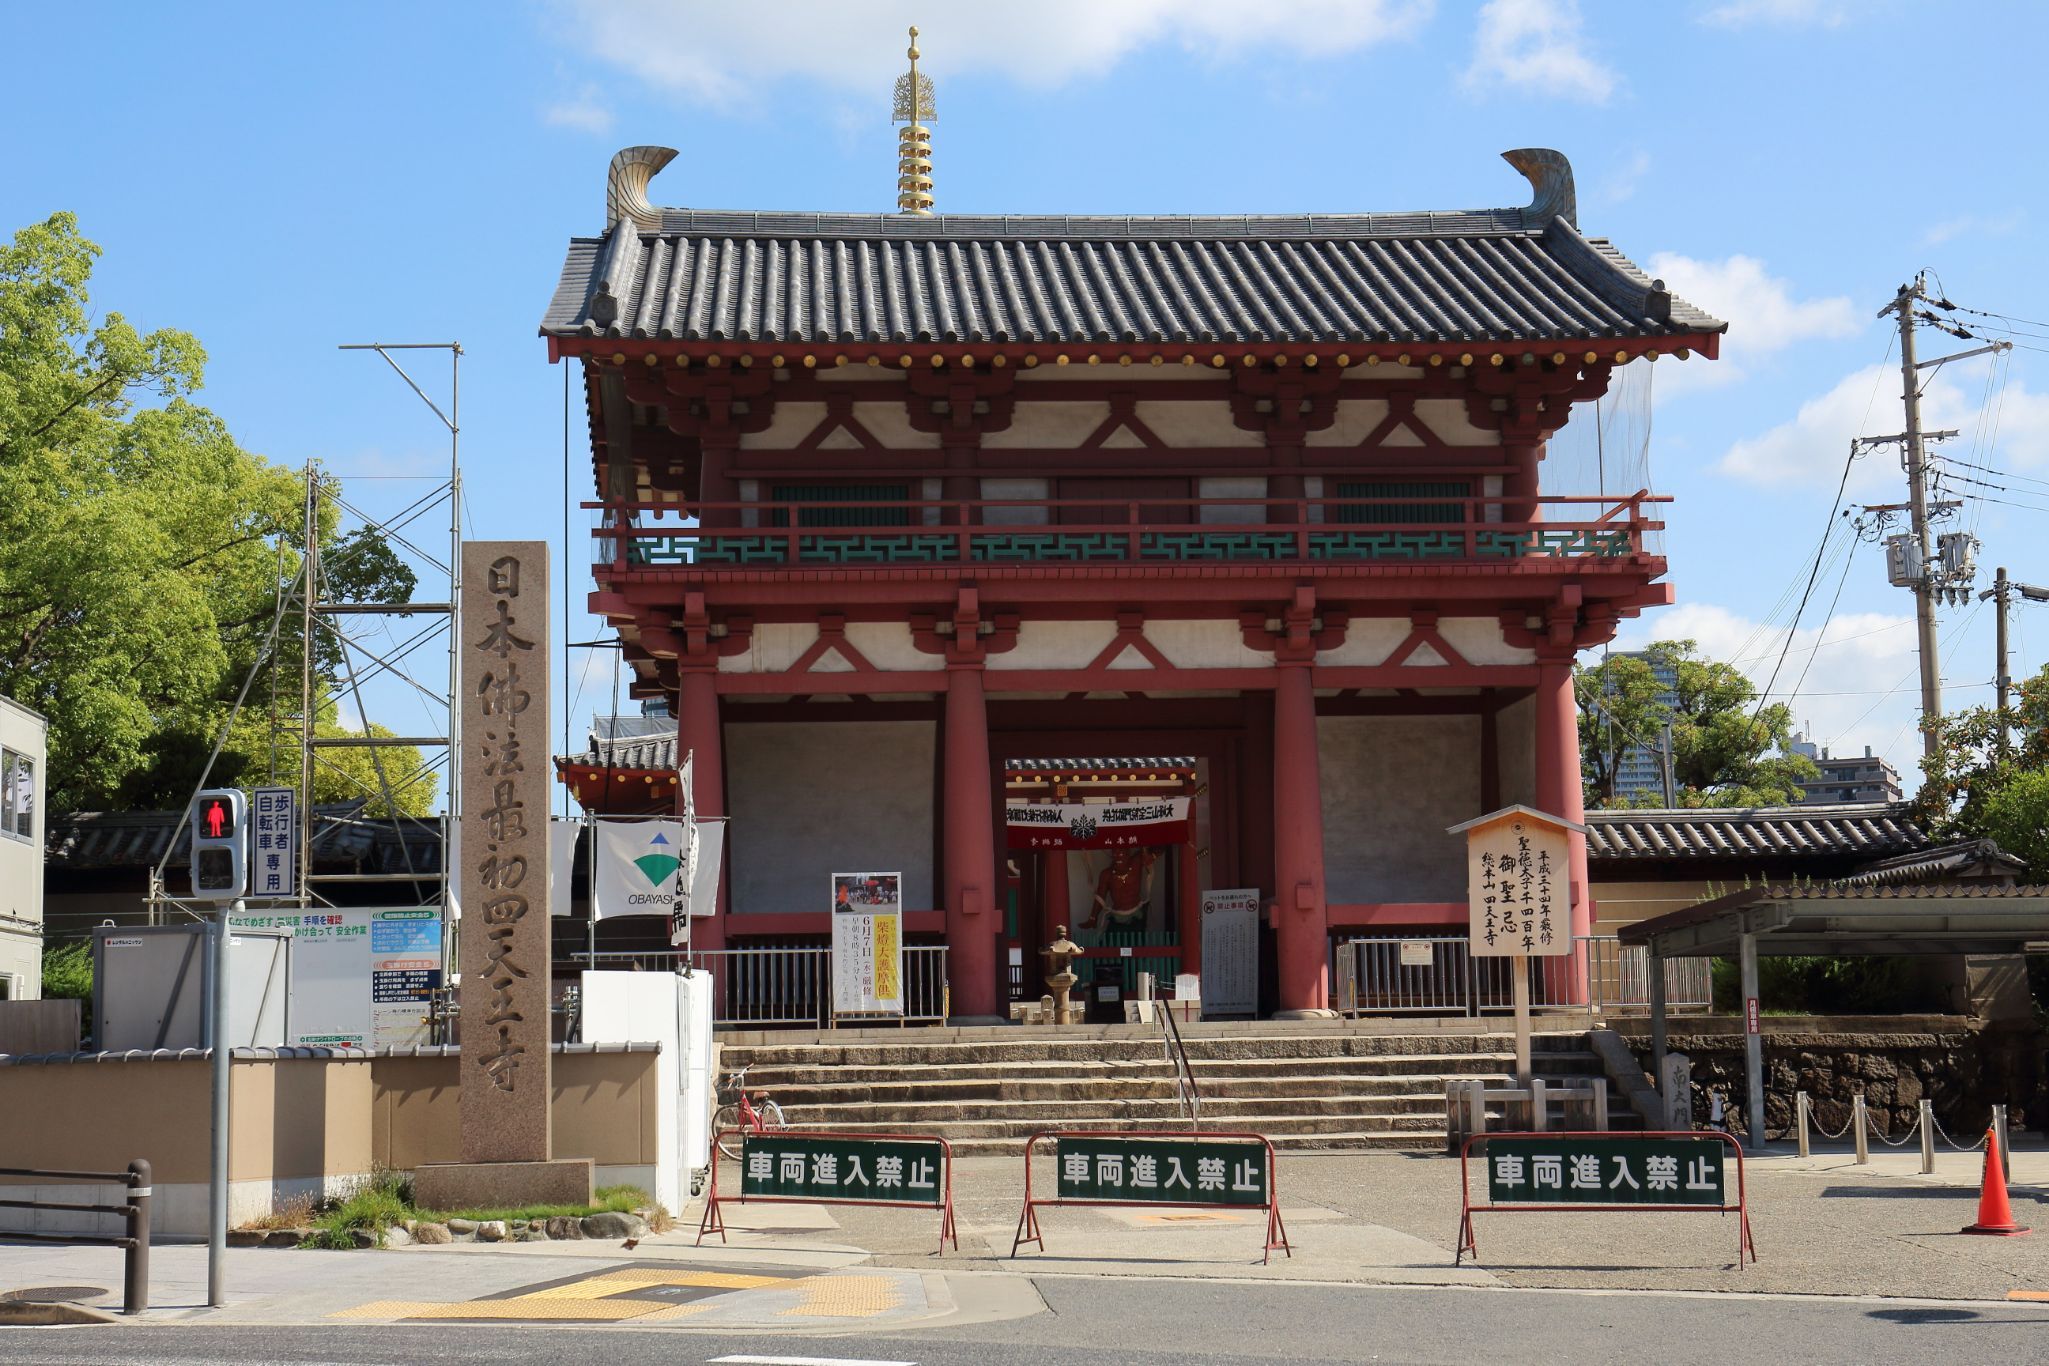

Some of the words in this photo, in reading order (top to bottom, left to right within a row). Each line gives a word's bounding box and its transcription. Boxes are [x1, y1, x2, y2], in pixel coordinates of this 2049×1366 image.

[259, 796, 273, 850] 自転車
[275, 795, 289, 849] 歩行者
[267, 854, 280, 890] 専用
[629, 894, 675, 905] OBAYASH
[1499, 854, 1517, 933] 御聖忌
[1518, 837, 1535, 953] 聖徳太子千四百年
[304, 915, 342, 926] 手順を確認
[336, 925, 367, 936] 安全作業
[1673, 1065, 1688, 1123] 南大門
[747, 1151, 936, 1189] 車両進入禁止
[1063, 1152, 1261, 1193] 車両進入禁止
[1494, 1154, 1718, 1190] 車両進入禁止
